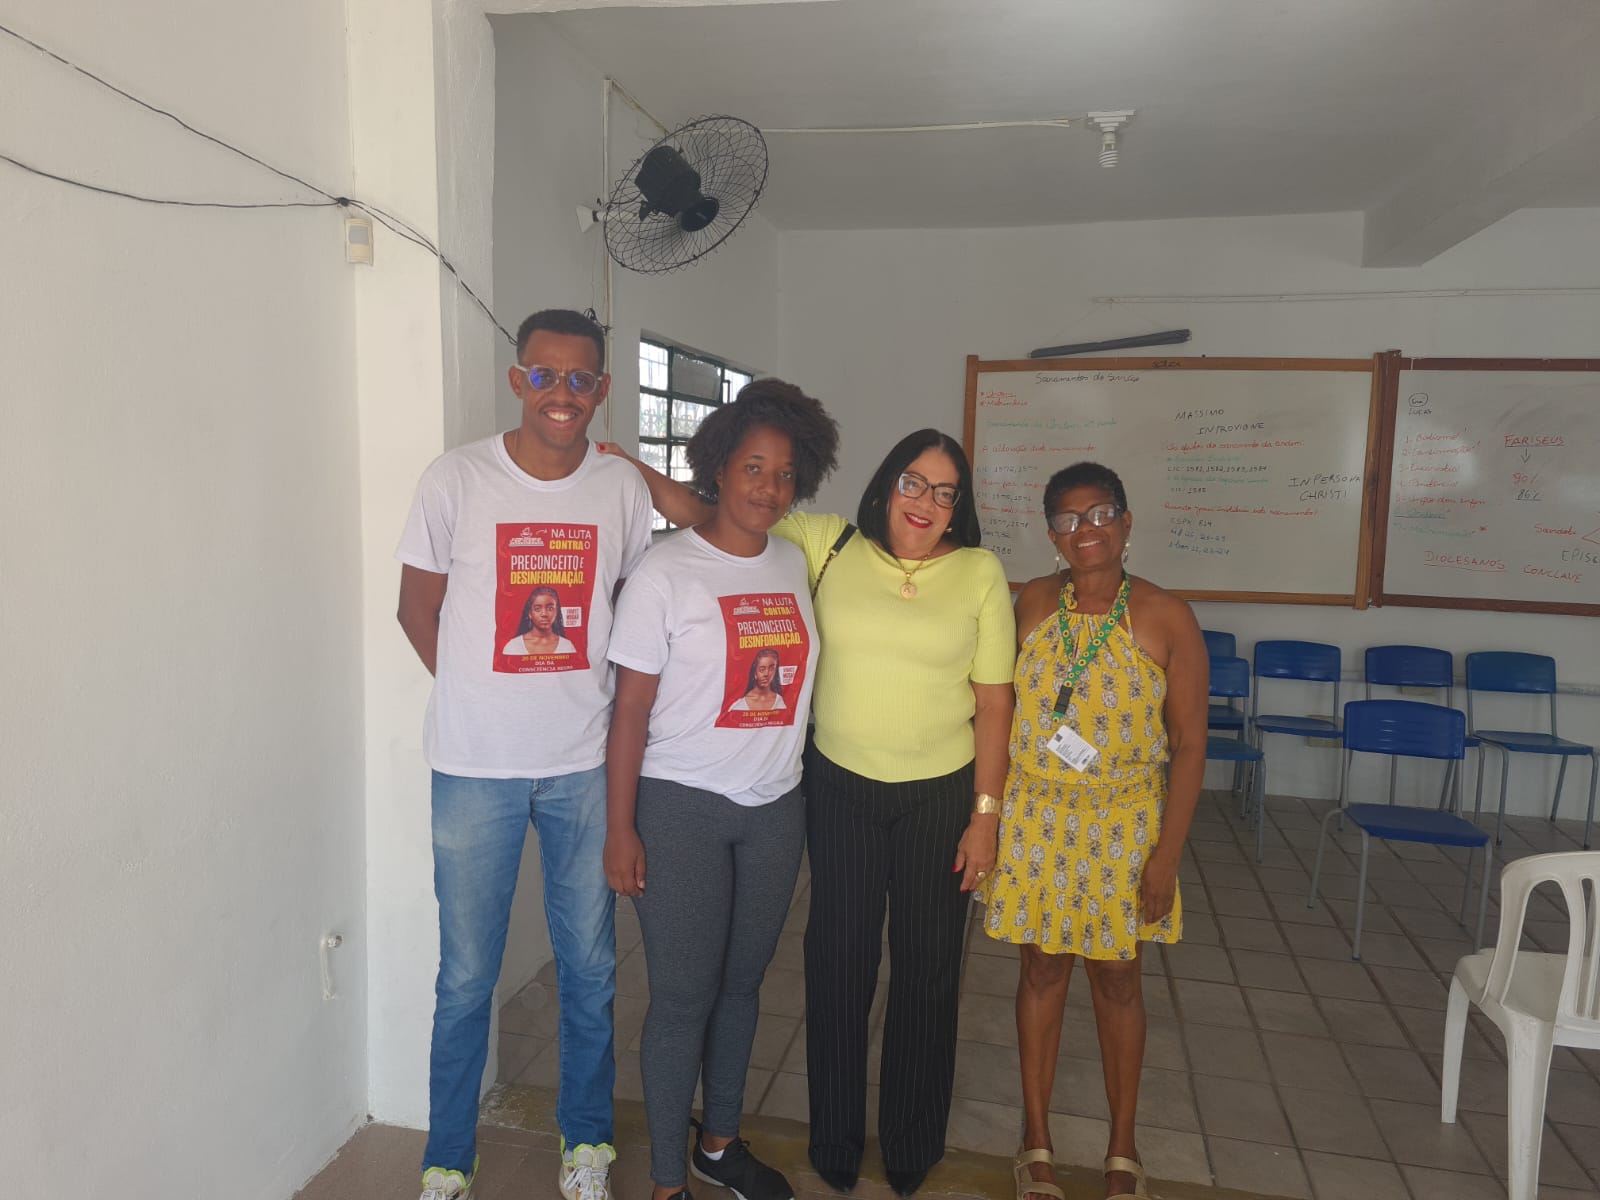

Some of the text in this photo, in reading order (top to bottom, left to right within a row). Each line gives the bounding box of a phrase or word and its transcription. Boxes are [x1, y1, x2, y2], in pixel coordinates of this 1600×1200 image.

[1174, 408, 1225, 421] MASSIMO
[1503, 434, 1566, 446] FARISEUS
[1299, 490, 1348, 503] CHRISTI
[551, 528, 592, 540] NA LUTA
[549, 539, 584, 551] CONTRA
[585, 541, 591, 550] O
[511, 554, 584, 571] PRECONCEITO E
[1521, 564, 1584, 584] CONCLAVE
[762, 597, 794, 607] NA LUTA
[763, 606, 790, 617] CONTRA
[790, 606, 795, 614] O
[737, 618, 797, 636] PRECONCEITO E
